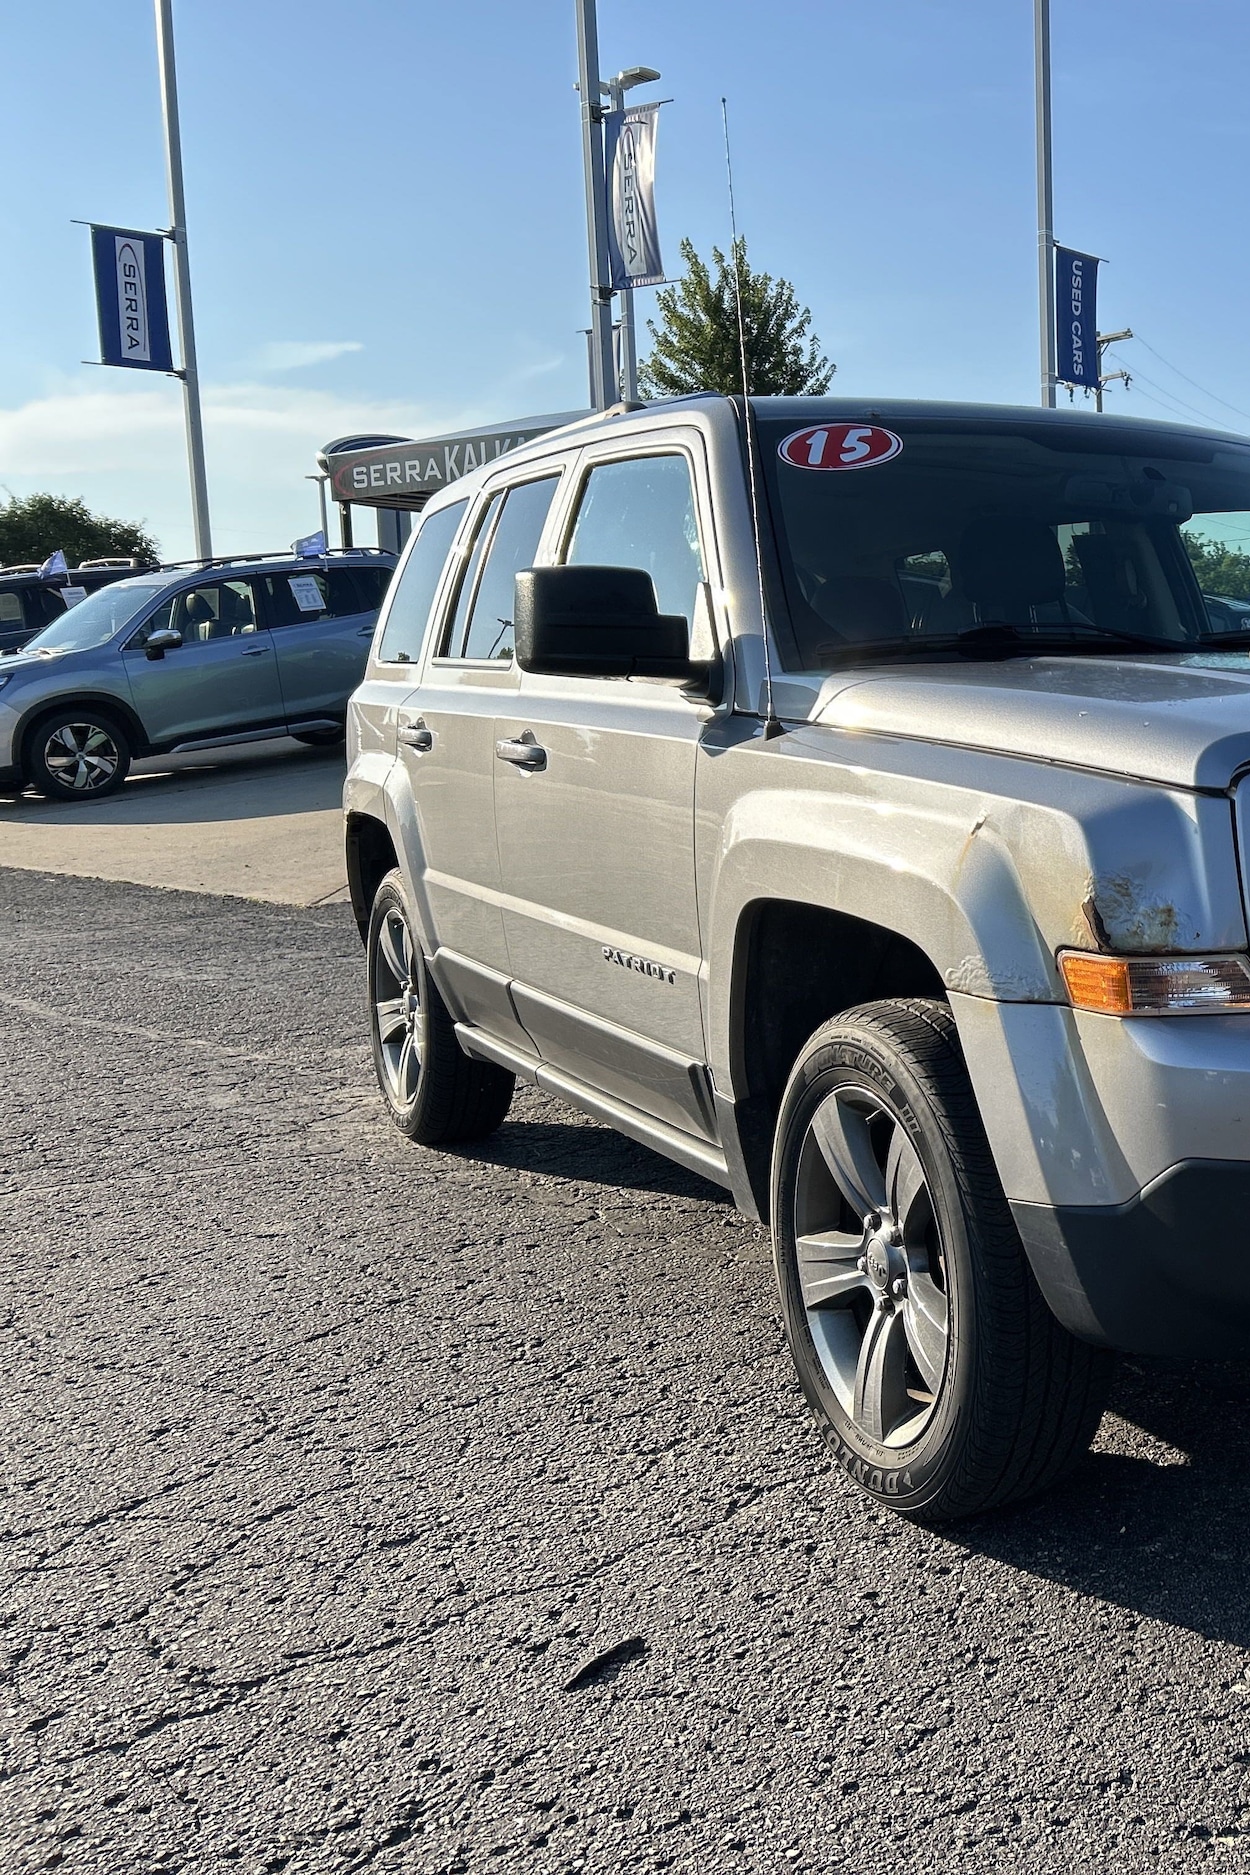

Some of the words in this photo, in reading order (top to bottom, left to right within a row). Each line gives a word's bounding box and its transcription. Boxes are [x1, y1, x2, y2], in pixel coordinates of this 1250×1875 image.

[624, 152, 638, 264] SERRA
[123, 263, 140, 350] SERRA
[1072, 260, 1083, 316] USED
[1071, 321, 1084, 376] CARS
[353, 458, 443, 489] SERRA
[444, 437, 526, 483] KAL
[806, 428, 872, 465] 15
[602, 946, 677, 985] PATRIOT
